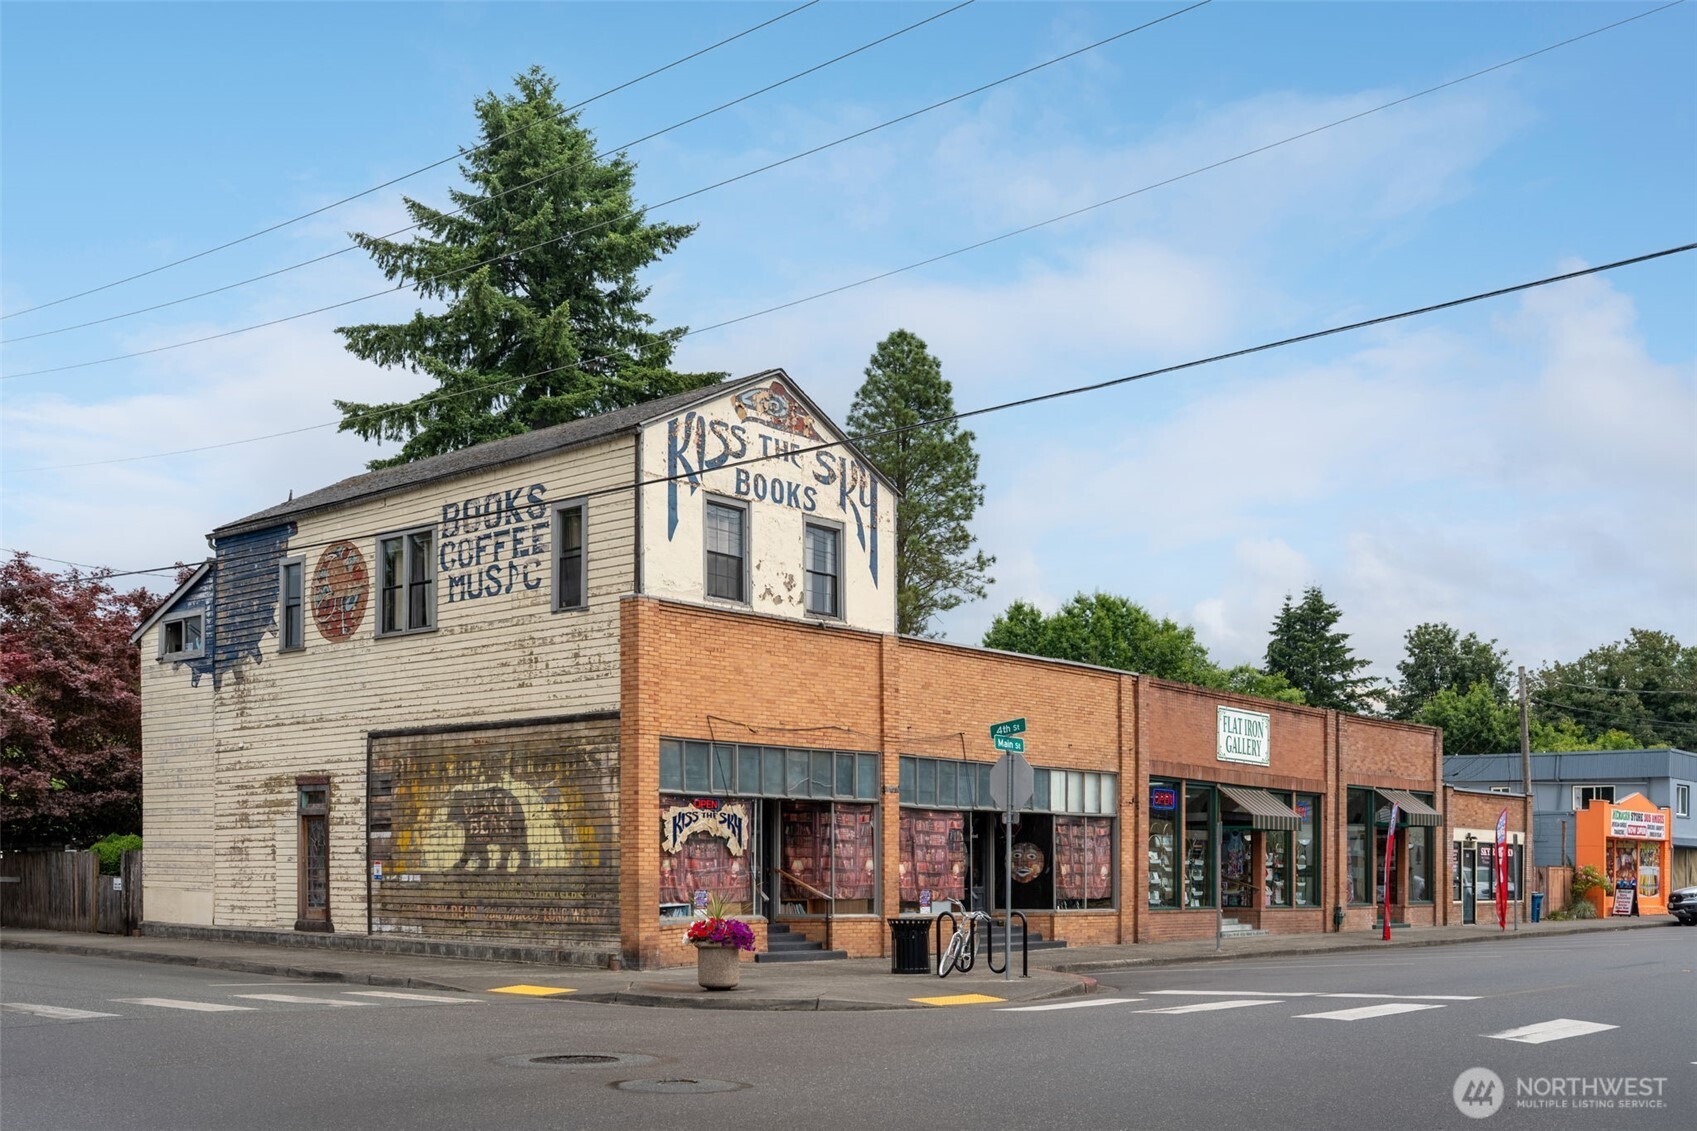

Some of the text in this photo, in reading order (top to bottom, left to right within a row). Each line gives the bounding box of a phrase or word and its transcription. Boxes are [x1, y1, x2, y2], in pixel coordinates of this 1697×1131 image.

[667, 411, 879, 590] KISS THE SKY
[735, 467, 818, 512] BOOKS
[441, 483, 547, 539] BOOKS
[440, 521, 550, 572] COFFEE
[996, 724, 1011, 735] 4th
[1223, 715, 1264, 738] FLAT IRON
[997, 738, 1022, 750] Main St
[1225, 735, 1262, 757] GALLERY
[694, 800, 718, 809] OPEN
[672, 811, 699, 848] KISS
[718, 812, 742, 848] SKY
